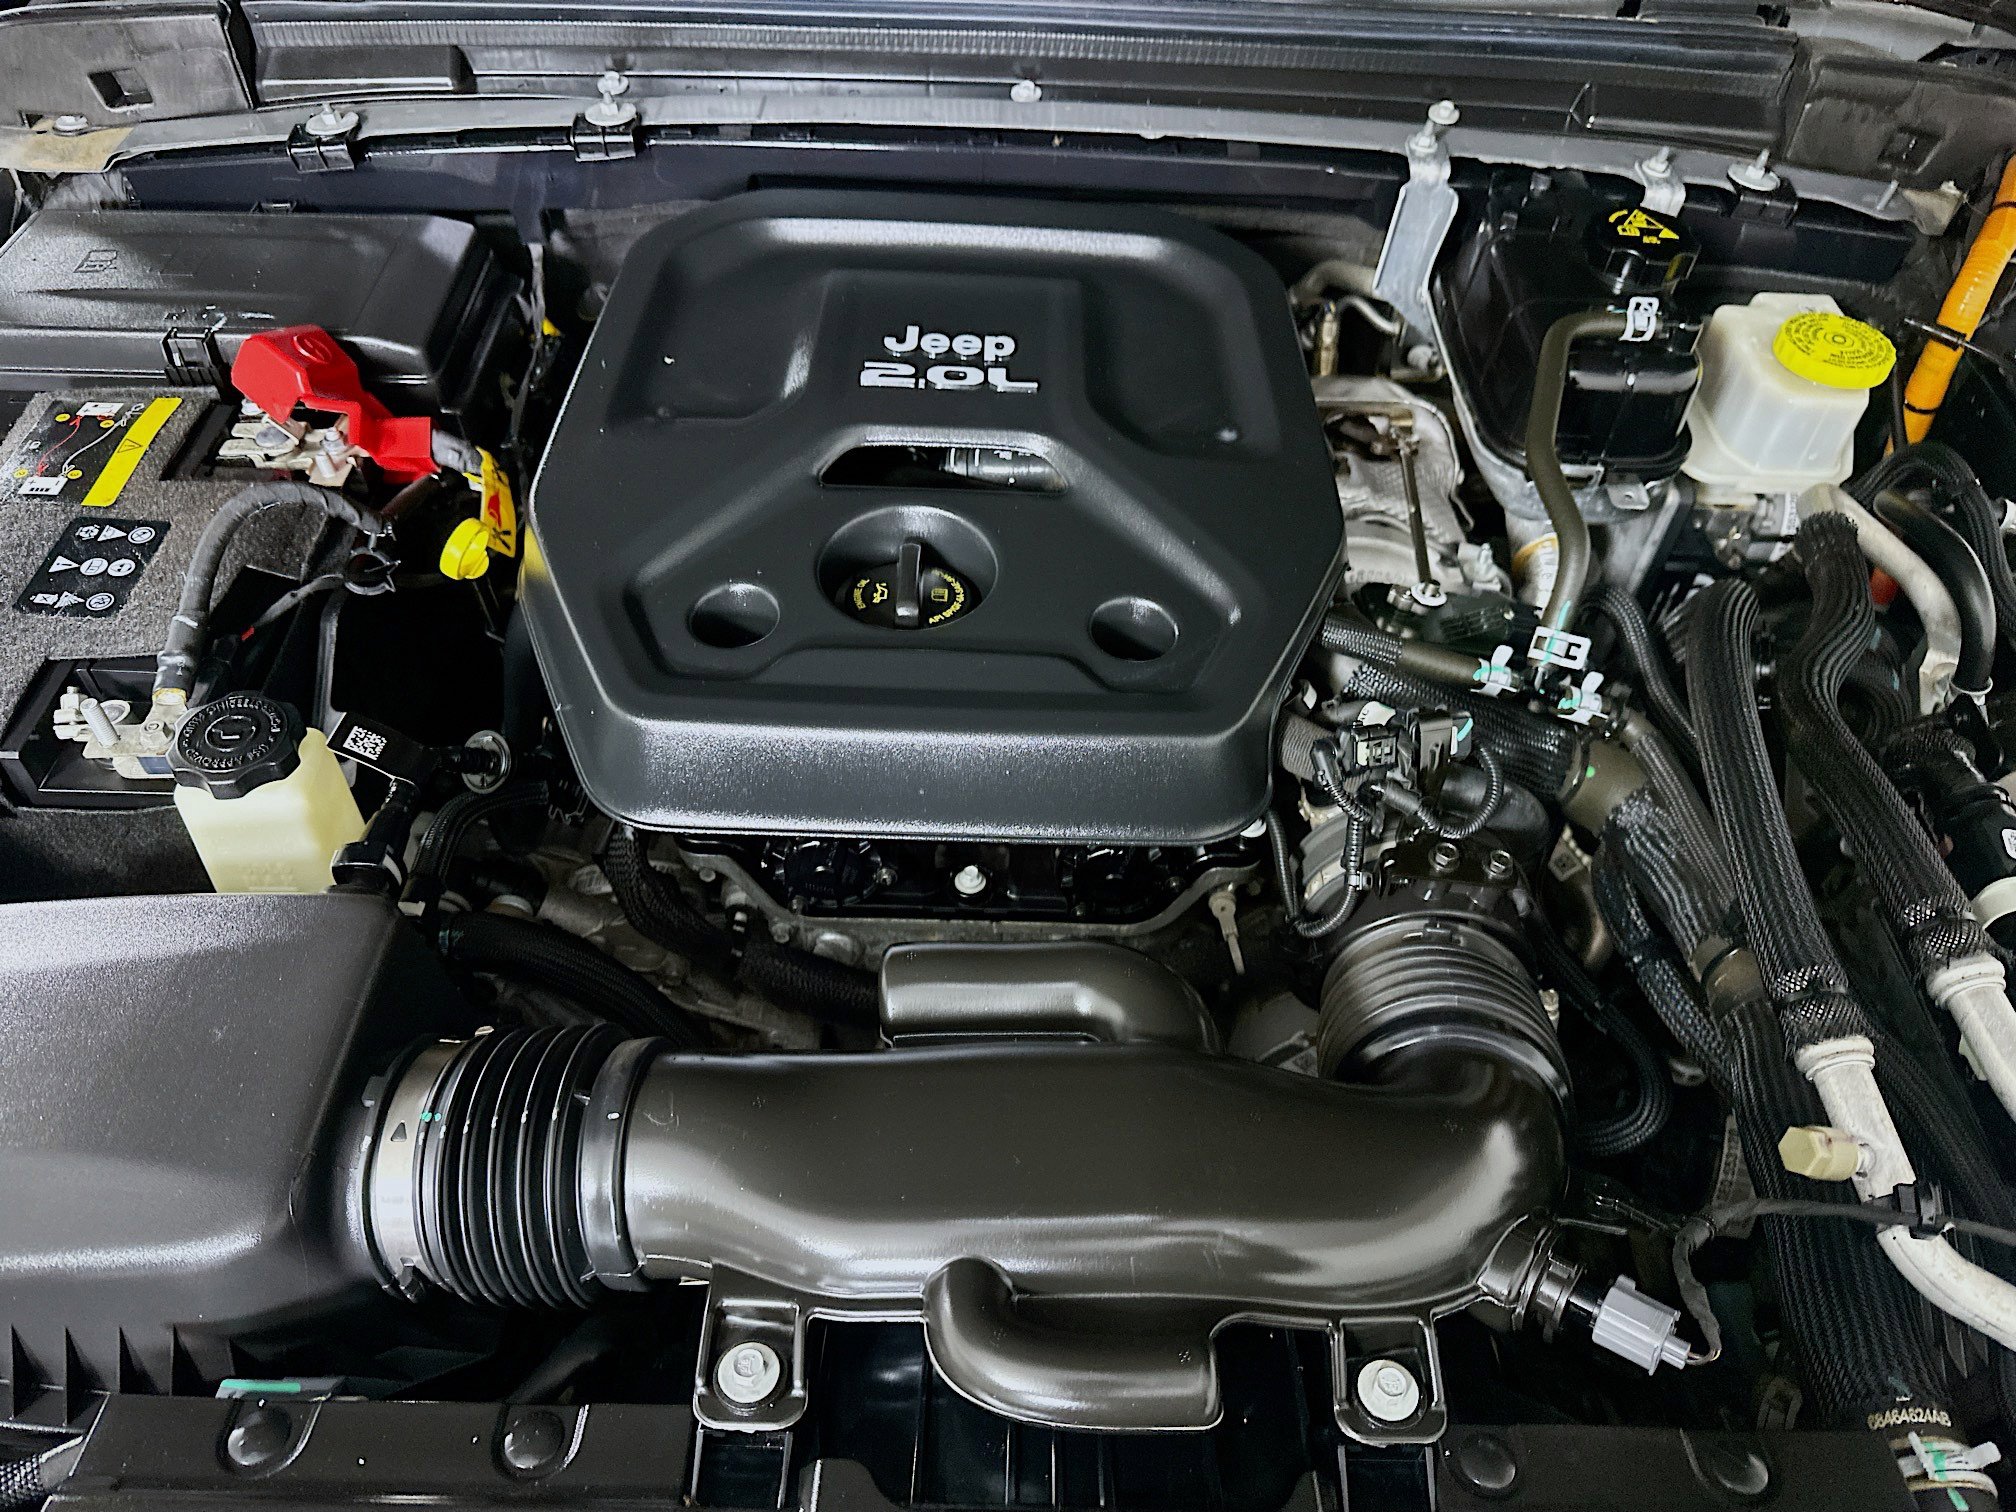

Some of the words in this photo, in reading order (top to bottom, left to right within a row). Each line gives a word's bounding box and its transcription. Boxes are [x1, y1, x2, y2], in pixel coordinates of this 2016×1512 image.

[883, 325, 1016, 362] Jeep
[859, 361, 1039, 393] 2.0L
[184, 748, 244, 769] APPROVED
